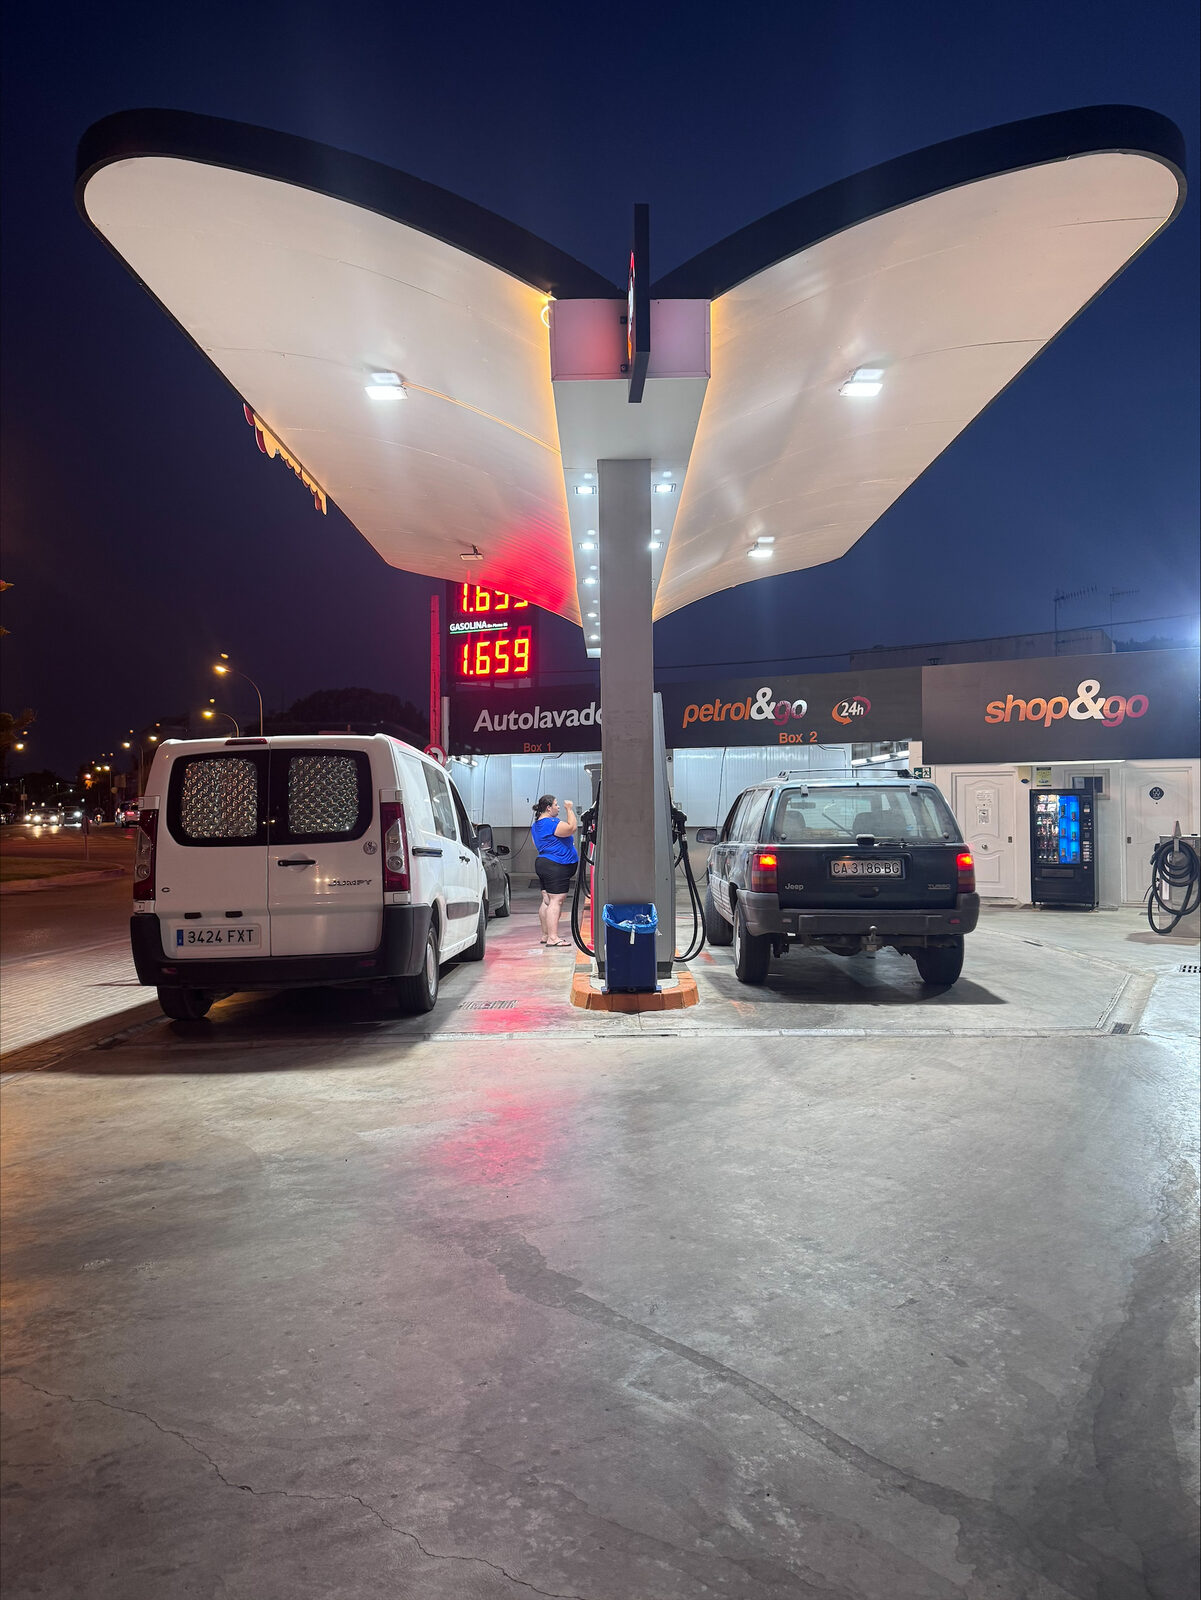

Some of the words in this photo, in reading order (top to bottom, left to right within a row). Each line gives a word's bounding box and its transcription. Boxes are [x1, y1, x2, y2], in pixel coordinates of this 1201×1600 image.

[449, 620, 487, 631] GASOLINA
[462, 638, 530, 675] 1.659
[682, 686, 808, 729] petrol&go
[840, 701, 865, 717] 24h
[984, 679, 1150, 728] shop&go
[779, 732, 803, 744] Box
[809, 731, 818, 743] 2
[523, 742, 542, 753] Box
[546, 742, 552, 753] 1
[785, 883, 804, 891] Jeep
[187, 930, 224, 944] 3424
[227, 929, 255, 943] FXT
